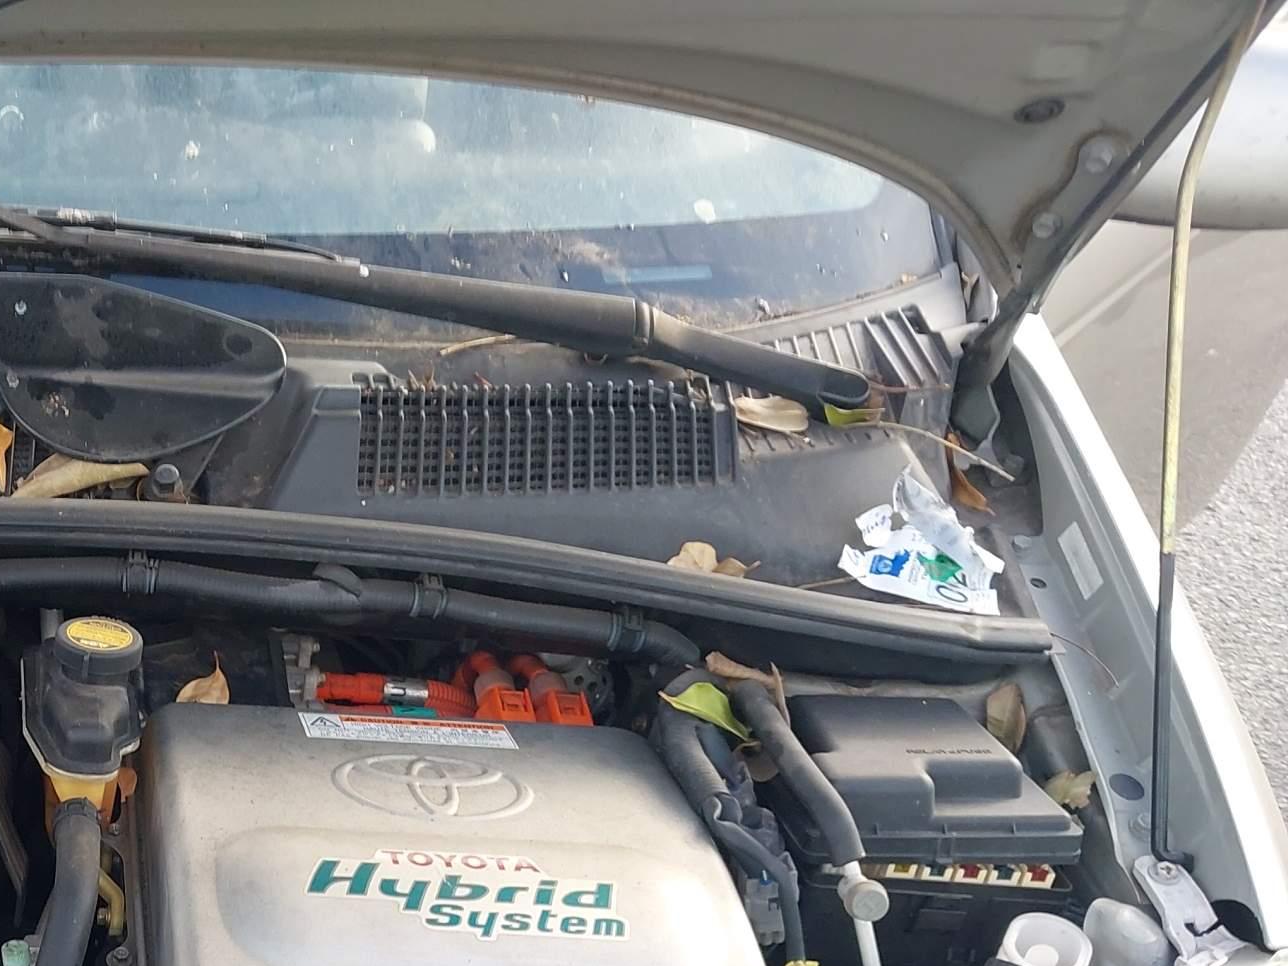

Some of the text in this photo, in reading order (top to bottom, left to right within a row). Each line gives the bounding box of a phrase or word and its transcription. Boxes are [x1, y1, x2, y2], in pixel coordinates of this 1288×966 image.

[380, 850, 541, 873] TOYOTA
[307, 859, 613, 911] Hybrid
[425, 904, 625, 938] System
